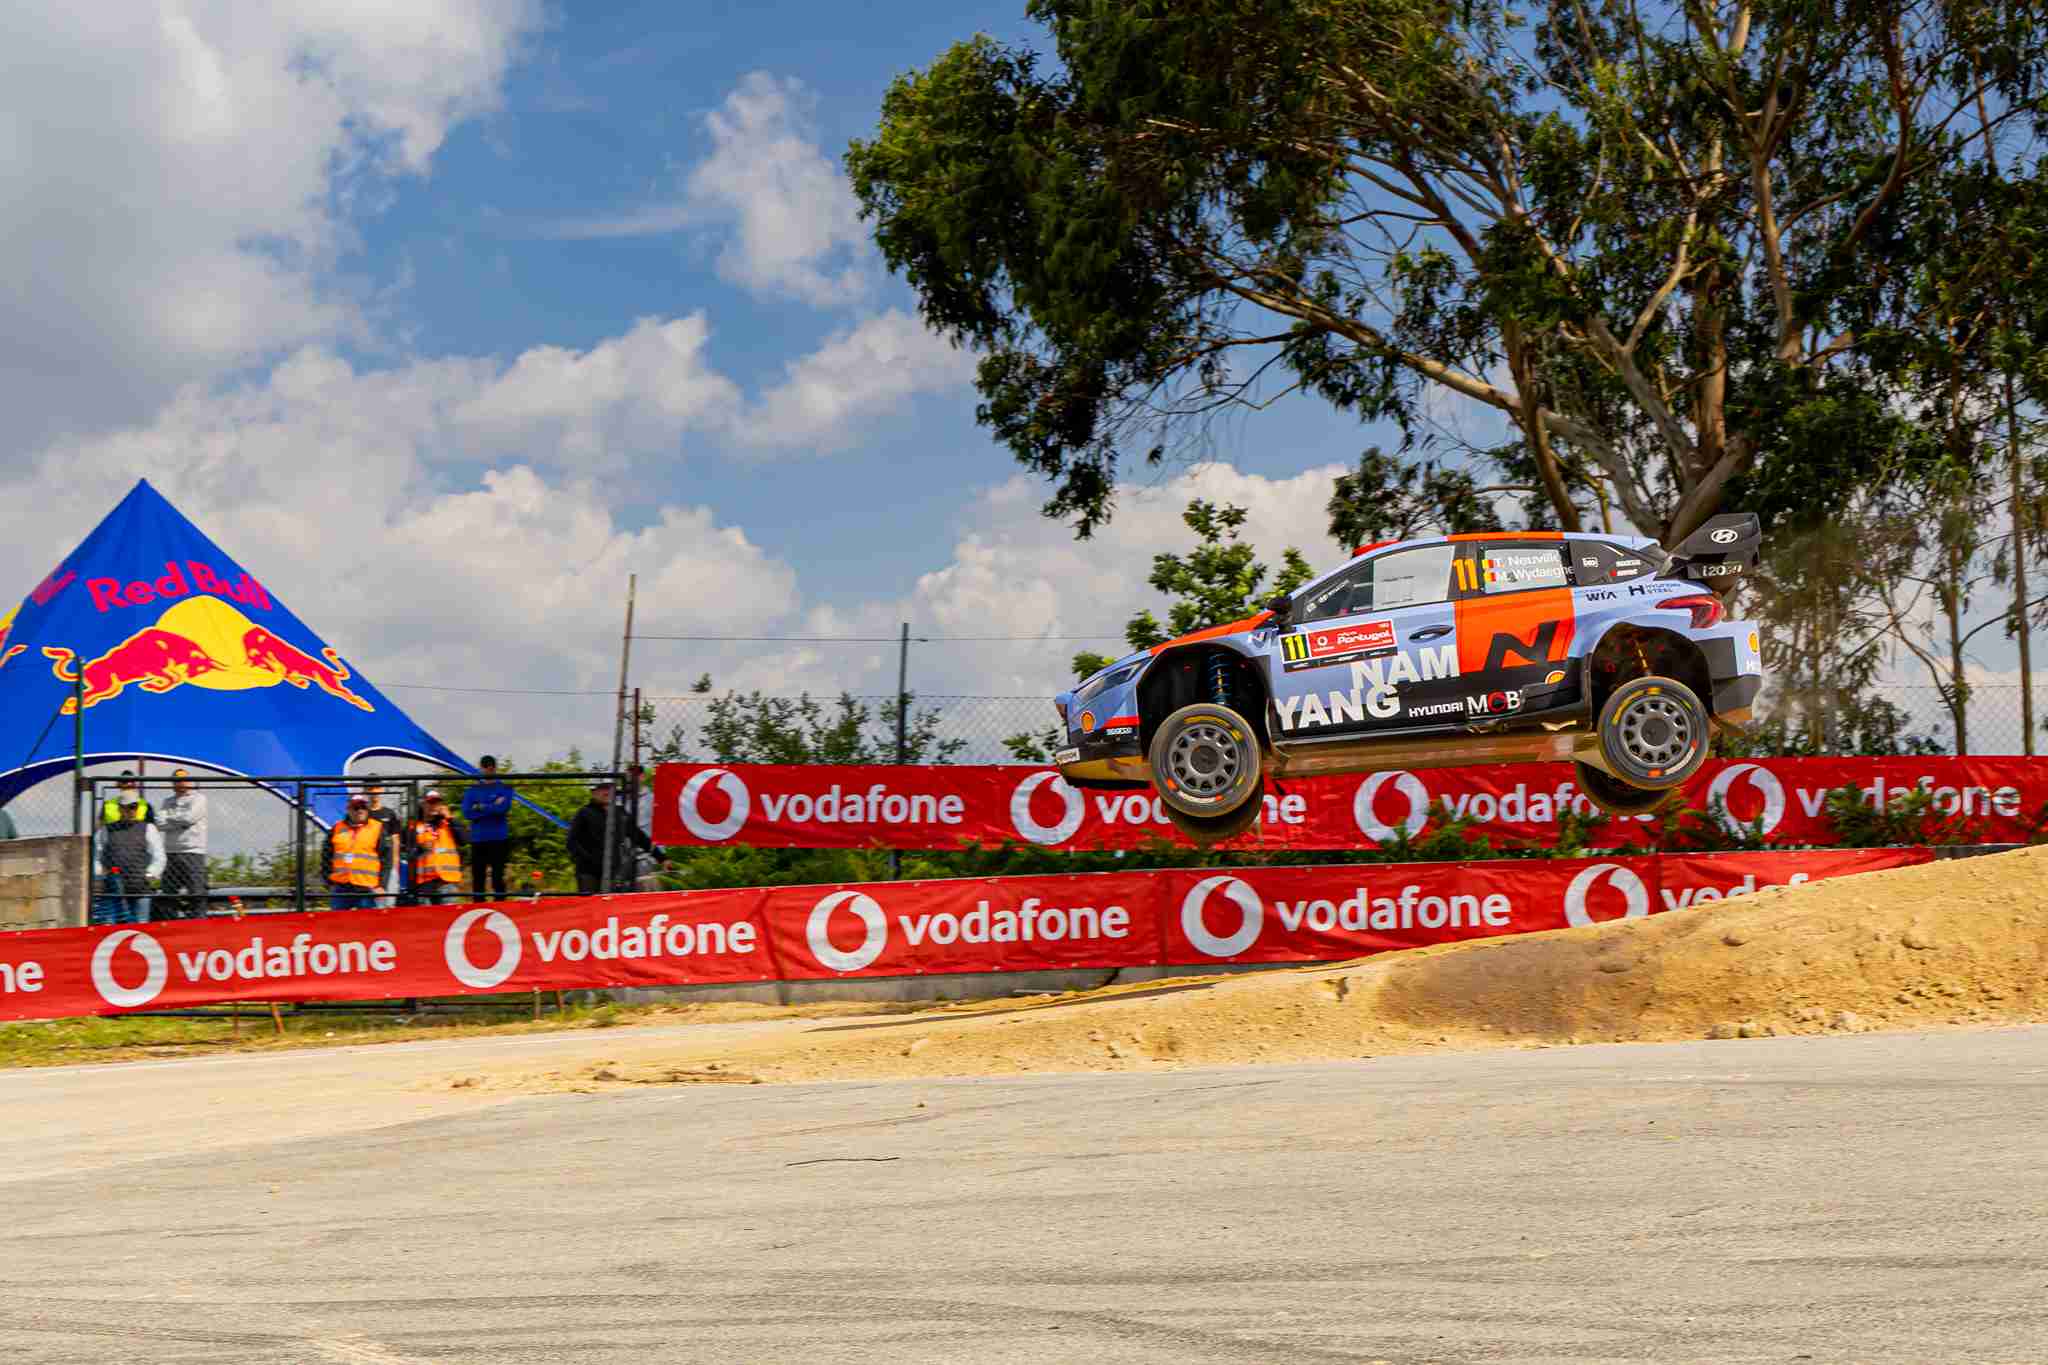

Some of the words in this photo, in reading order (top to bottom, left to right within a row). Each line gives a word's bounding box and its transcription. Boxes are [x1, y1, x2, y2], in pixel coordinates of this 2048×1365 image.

[87, 561, 189, 612] Red
[187, 560, 272, 610] Bull
[1453, 559, 1478, 591] 11
[1285, 634, 1306, 660] 11
[1337, 630, 1392, 644] Portugal
[1351, 645, 1460, 689] NAM
[1275, 683, 1400, 731] YANG
[1409, 702, 1463, 718] HYUNDAI
[760, 784, 964, 824] vodafone
[900, 898, 1129, 946] vodafone
[1276, 885, 1512, 932] vodafone
[178, 934, 395, 982] vodafone
[532, 914, 756, 962] vodafone
